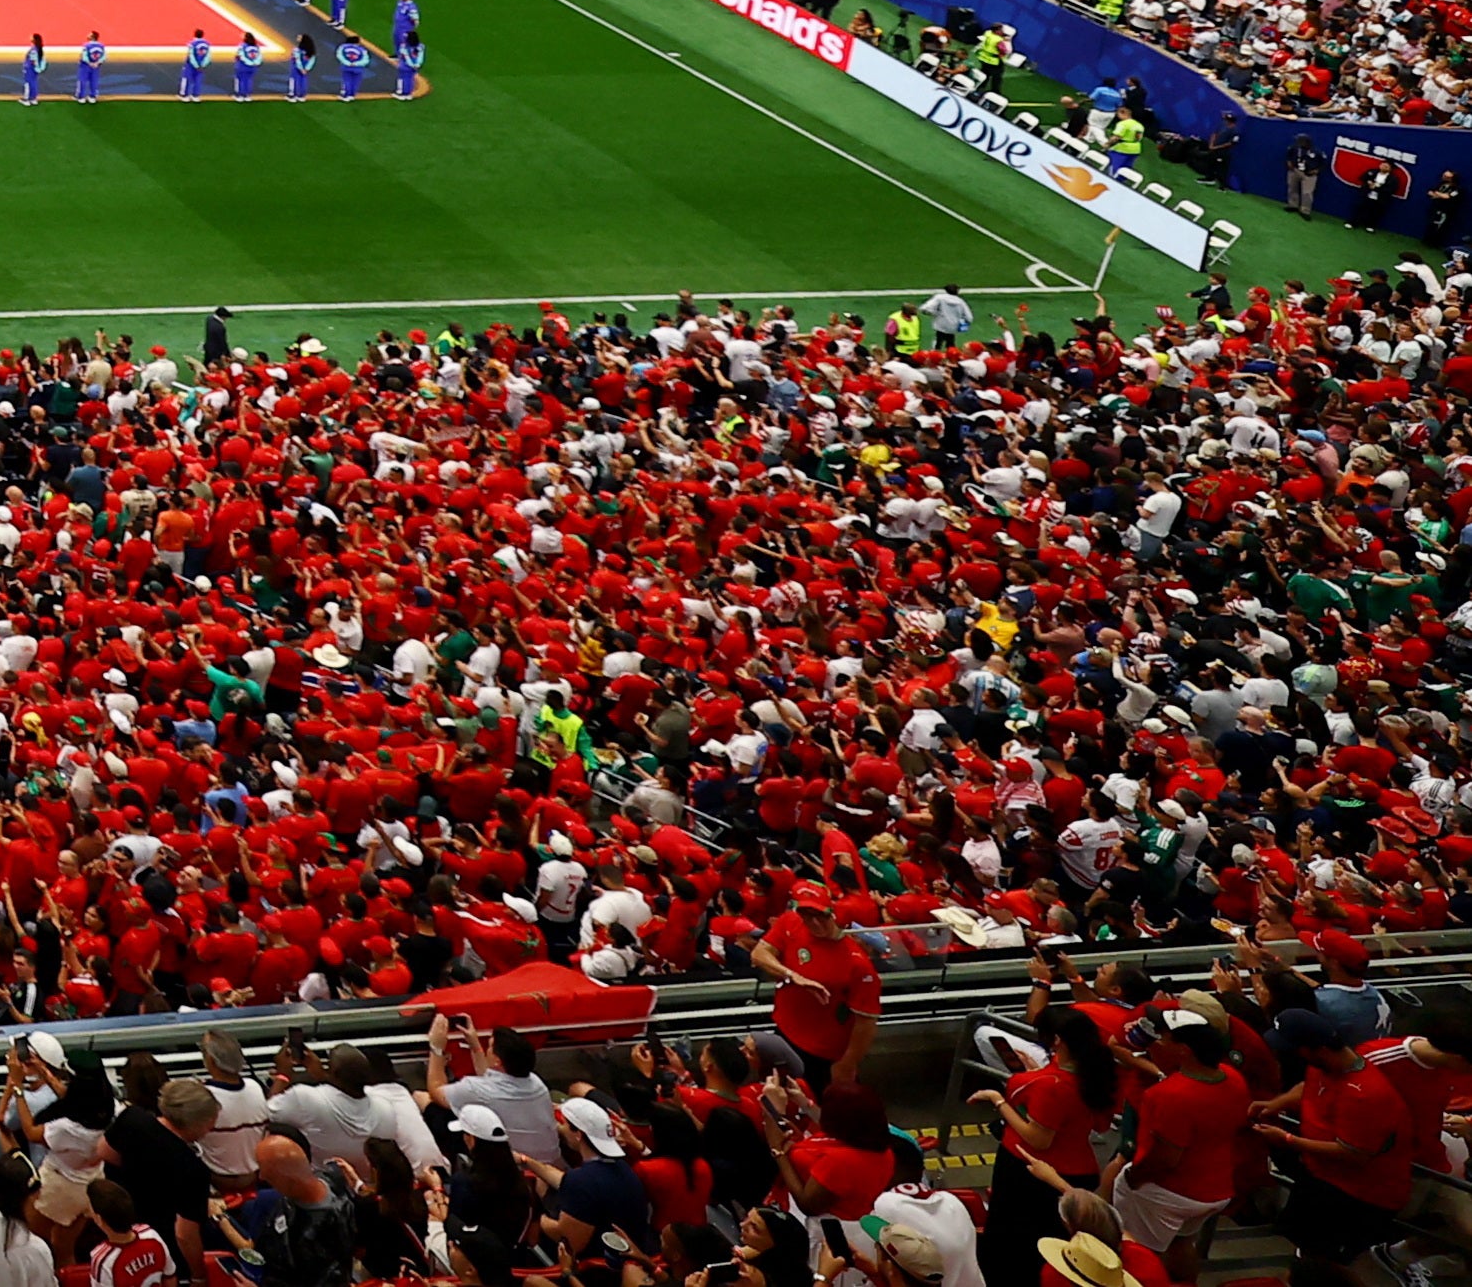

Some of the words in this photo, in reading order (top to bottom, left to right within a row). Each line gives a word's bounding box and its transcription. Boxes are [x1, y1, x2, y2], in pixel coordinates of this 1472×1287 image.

[925, 86, 1031, 168] Dove
[1336, 135, 1370, 153] WE
[125, 1251, 156, 1276] FELIX
